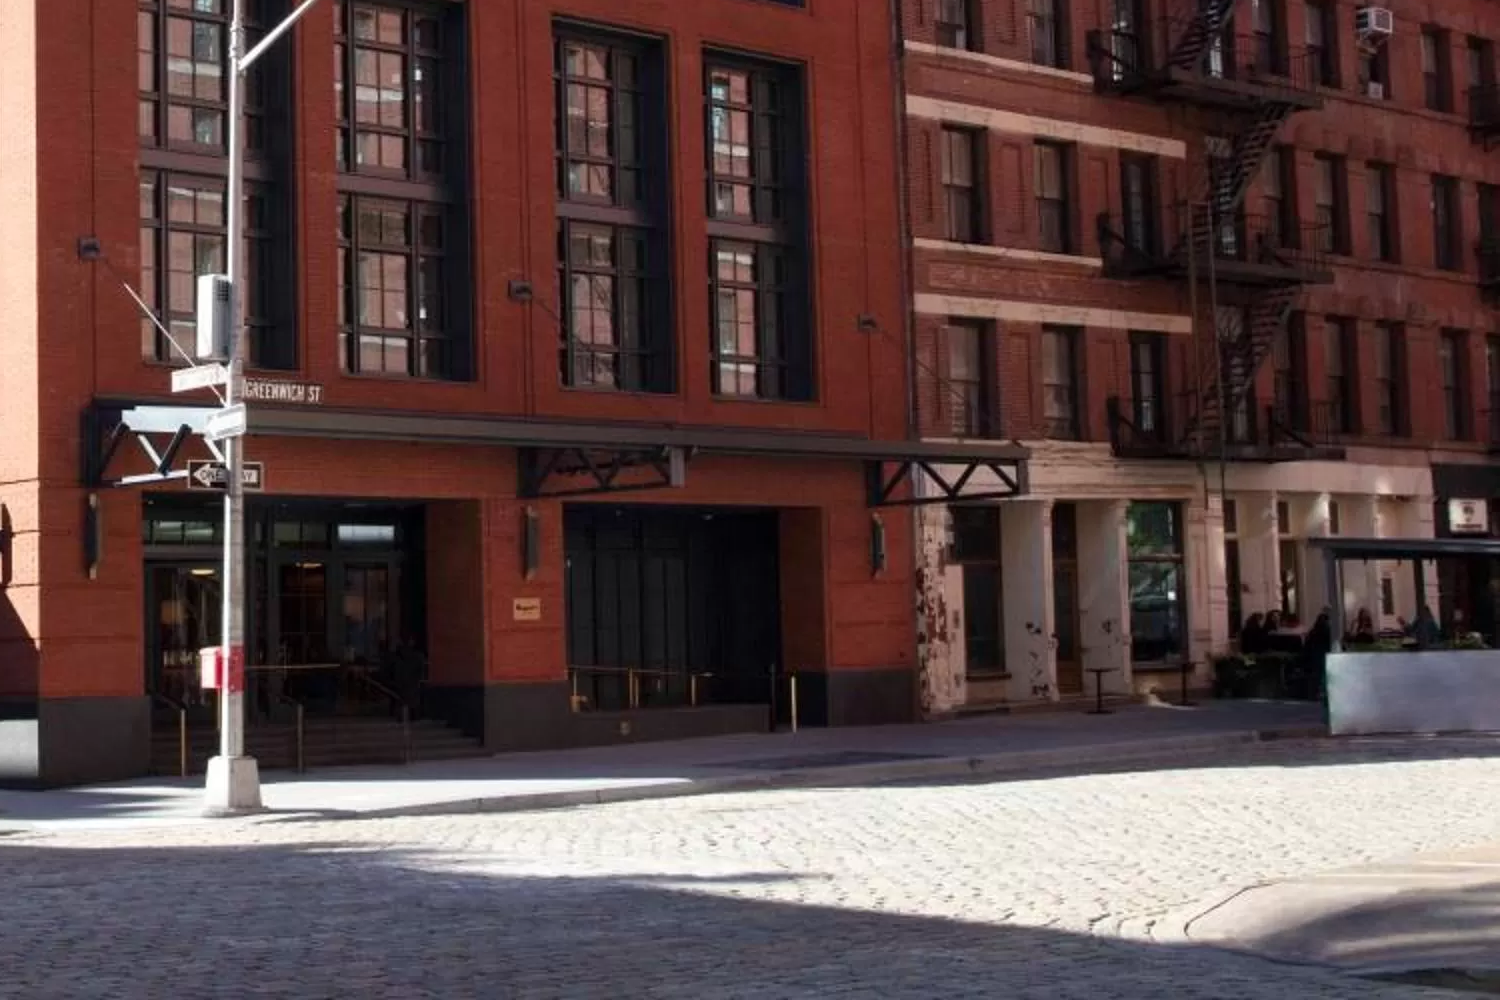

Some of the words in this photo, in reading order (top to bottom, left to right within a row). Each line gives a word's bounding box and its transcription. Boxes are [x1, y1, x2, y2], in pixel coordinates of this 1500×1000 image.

[246, 381, 305, 401] GREENWICH
[308, 385, 321, 402] ST
[200, 469, 225, 481] ONE
